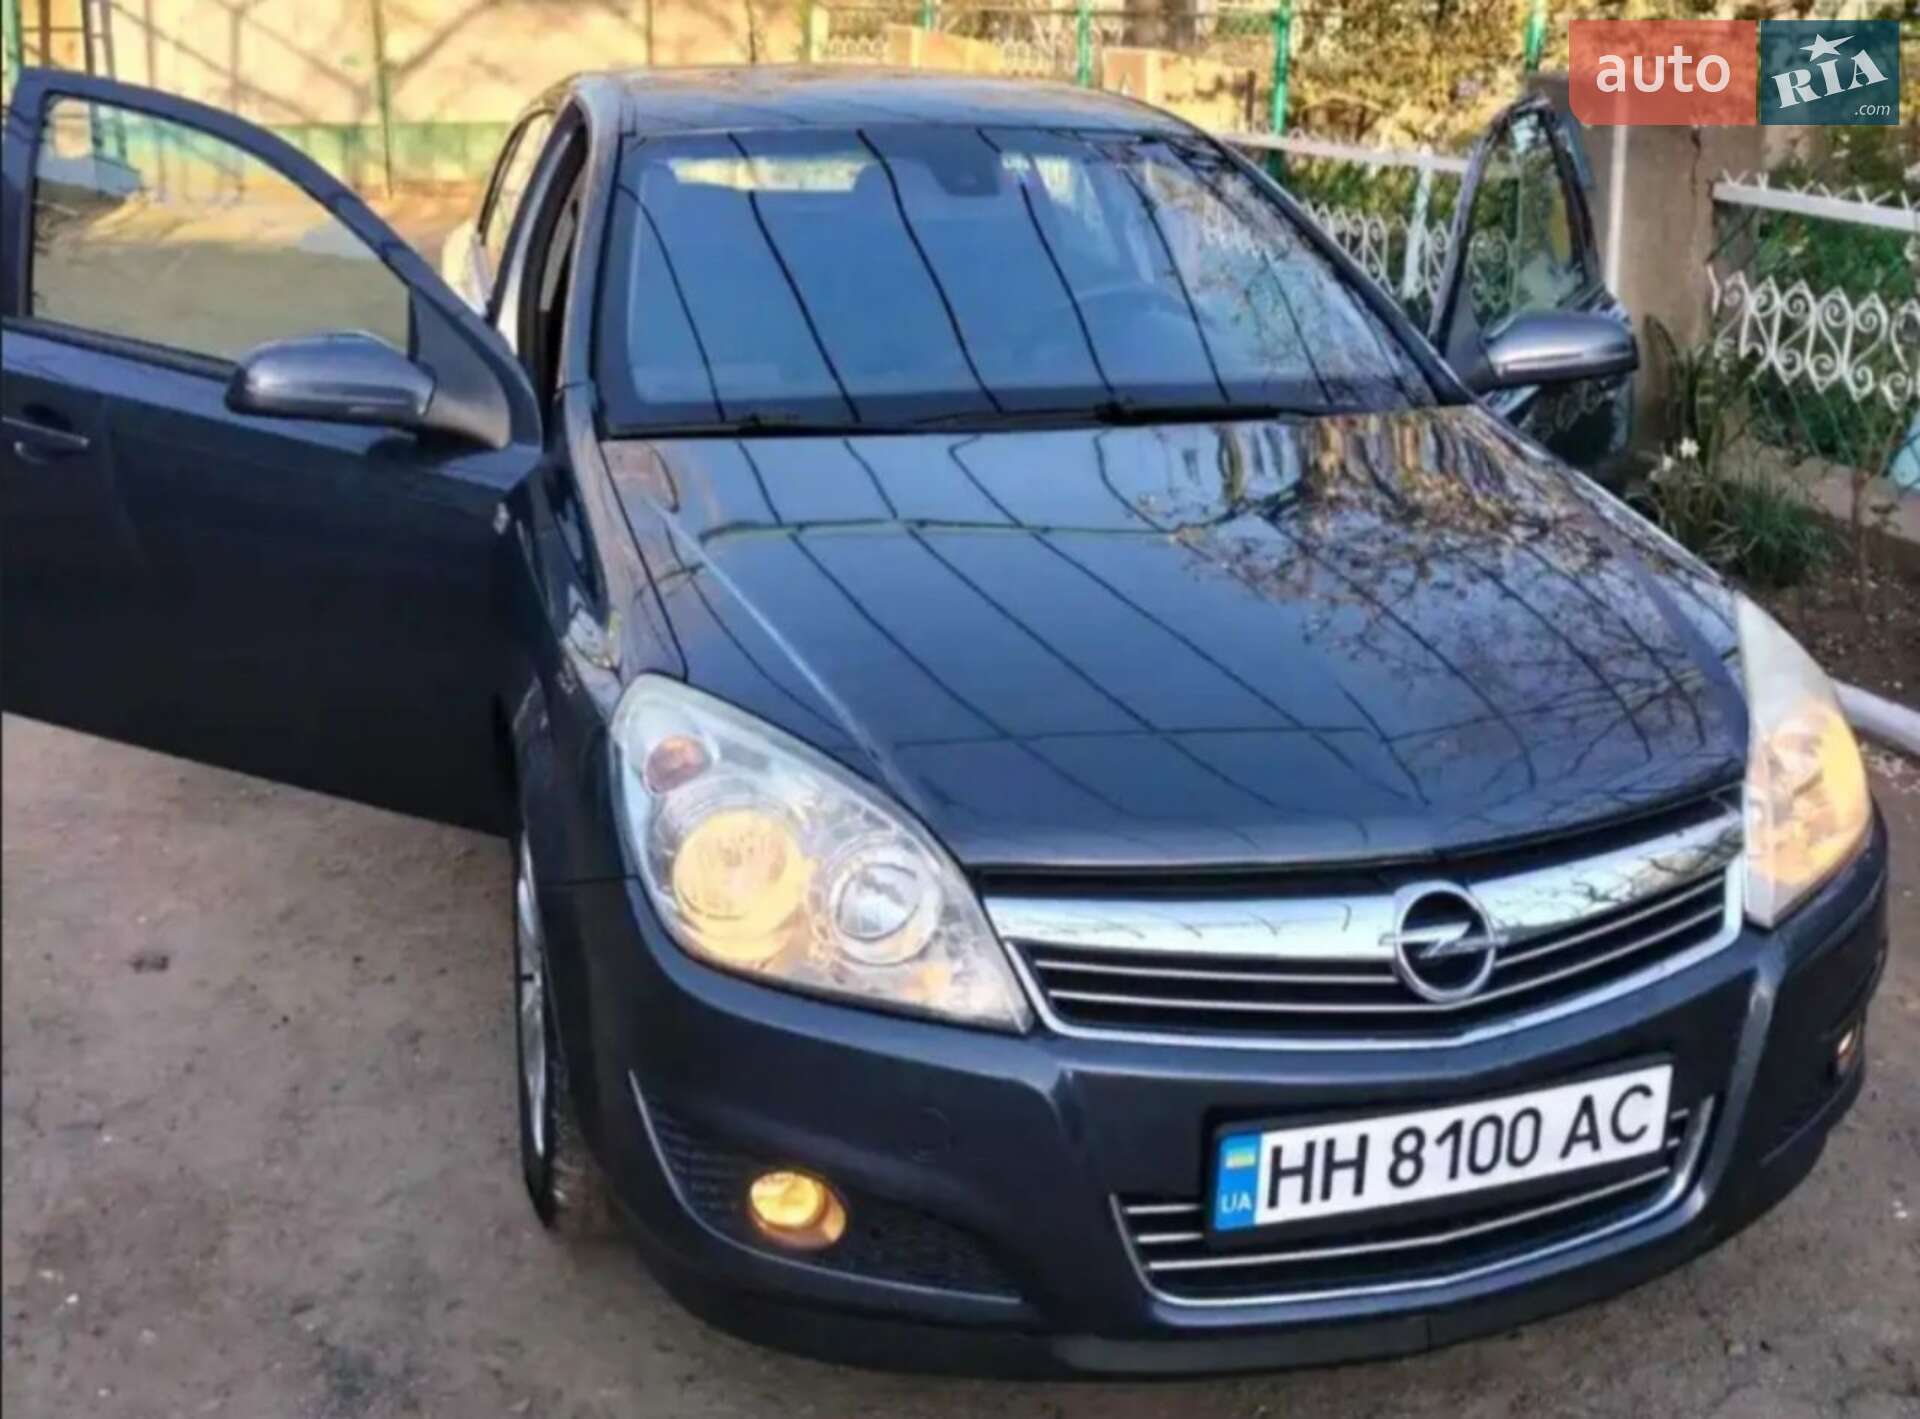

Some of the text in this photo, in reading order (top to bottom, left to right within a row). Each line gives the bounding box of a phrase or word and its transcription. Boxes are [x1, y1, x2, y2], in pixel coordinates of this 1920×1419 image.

[1266, 1084, 1654, 1209] HH 8100 AC
[1220, 1193, 1252, 1214] UA
